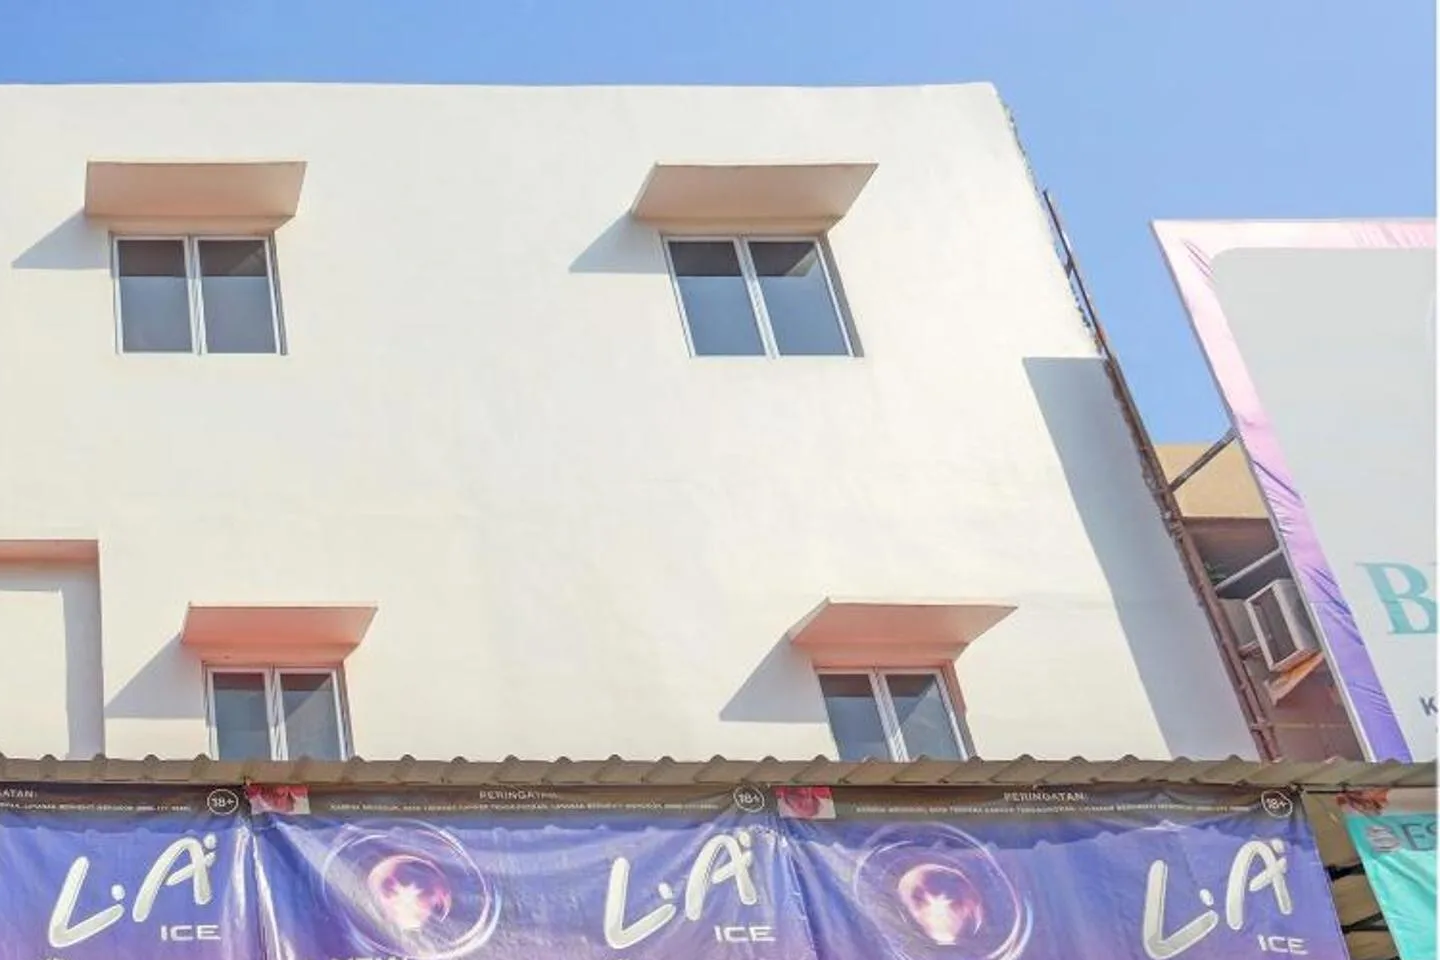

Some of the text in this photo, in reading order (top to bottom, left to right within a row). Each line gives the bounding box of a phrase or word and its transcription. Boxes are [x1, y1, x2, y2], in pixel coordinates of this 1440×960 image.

[160, 925, 221, 941] ICE
[714, 925, 776, 942] ICE
[1257, 935, 1308, 955] ICE
